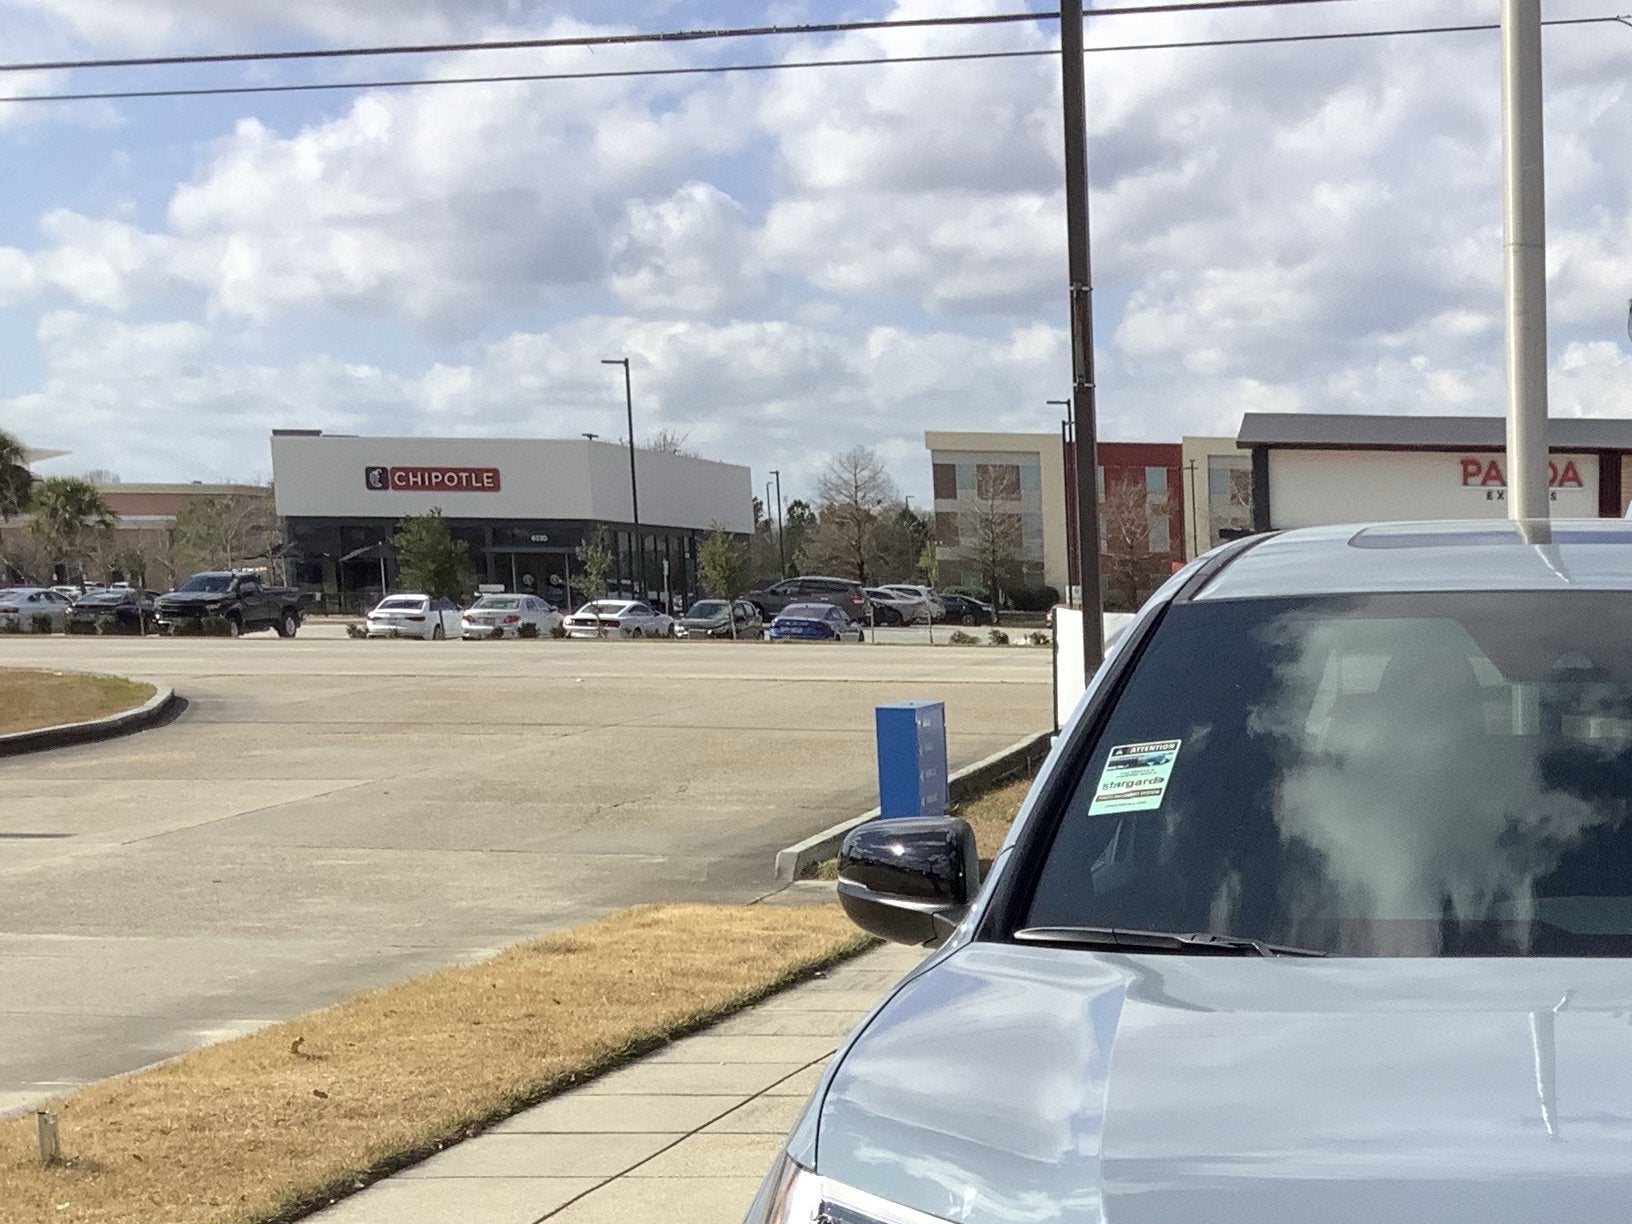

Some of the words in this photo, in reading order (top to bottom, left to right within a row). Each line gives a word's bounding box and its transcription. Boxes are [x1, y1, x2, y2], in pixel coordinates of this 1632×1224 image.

[394, 471, 494, 488] CHIPOTLE
[1460, 459, 1583, 487] PAA
[1129, 743, 1176, 755] ATTENTION
